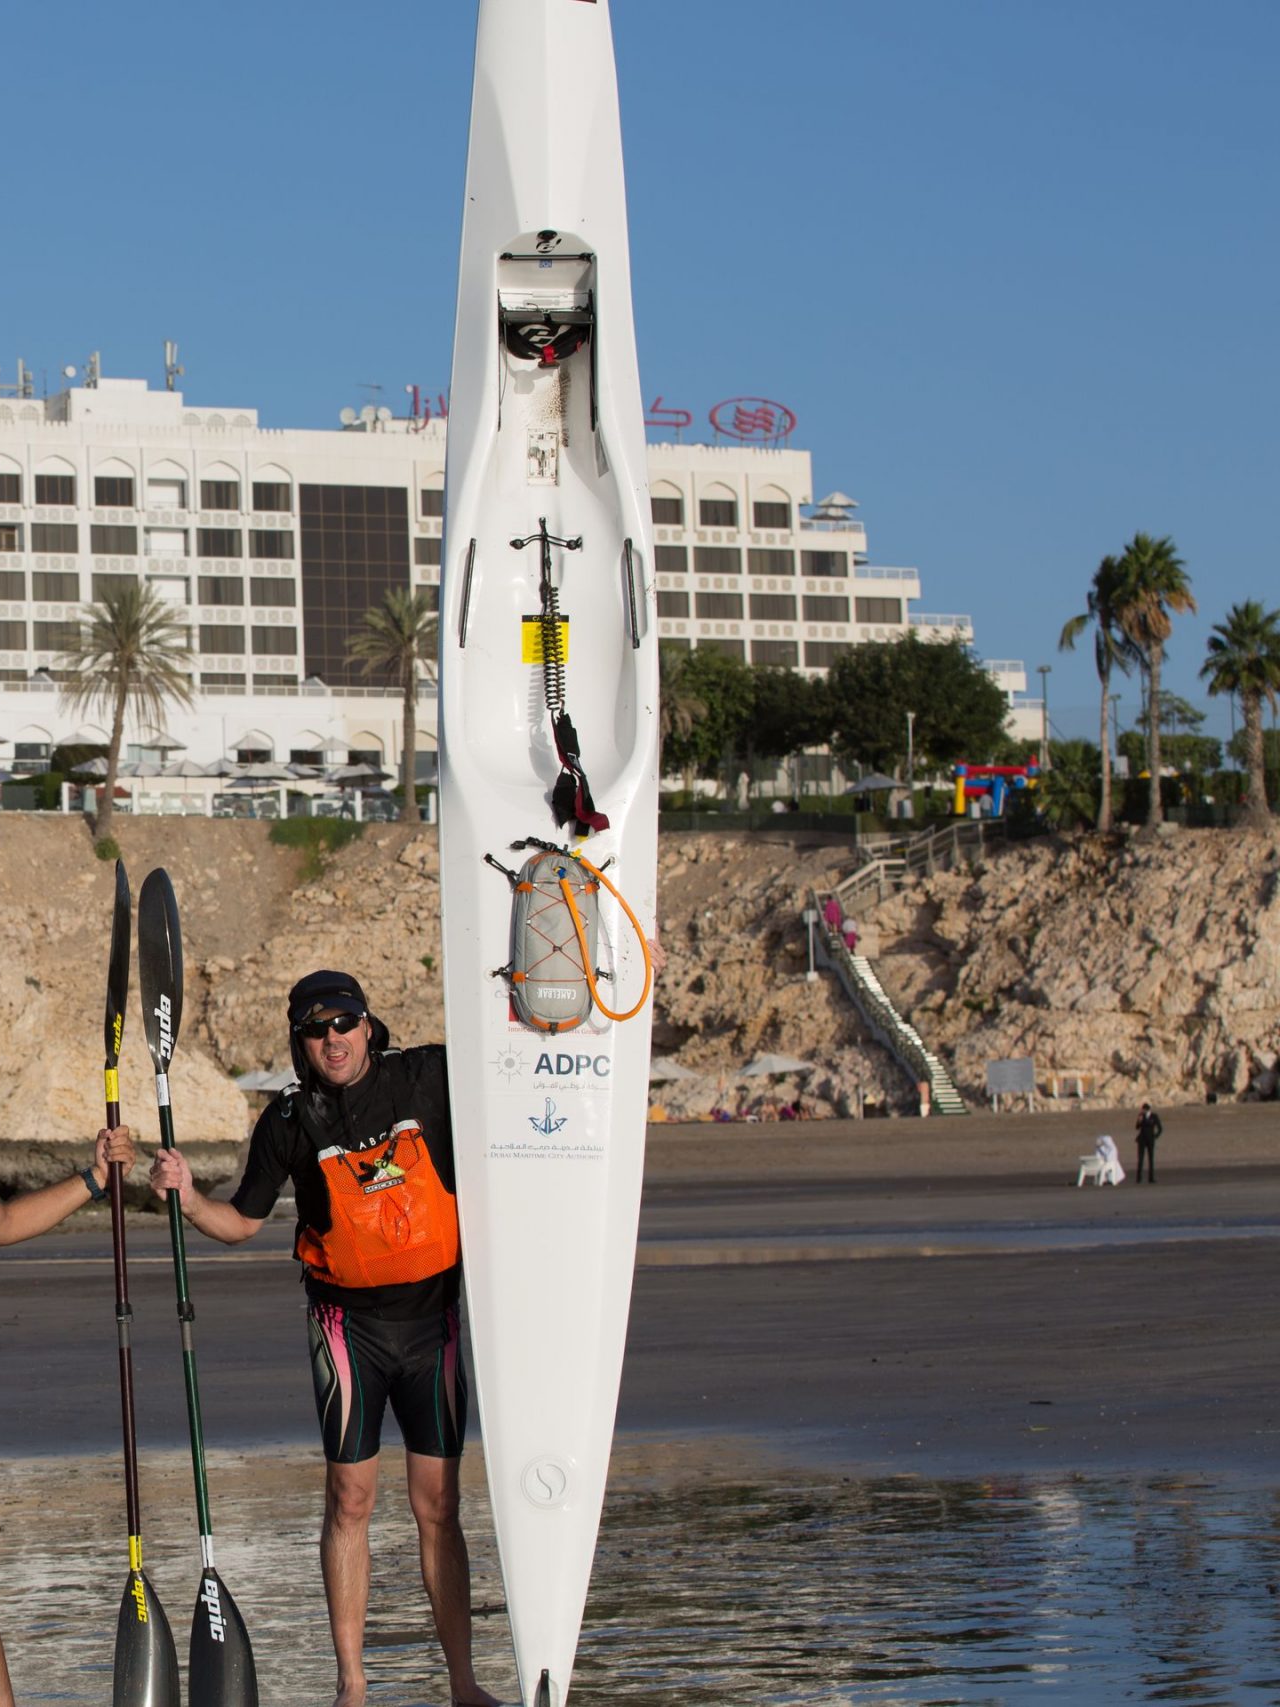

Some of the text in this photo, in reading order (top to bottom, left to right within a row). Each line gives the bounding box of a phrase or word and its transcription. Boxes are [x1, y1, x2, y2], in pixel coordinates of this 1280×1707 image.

[536, 987, 577, 1000] CAMELBAK
[154, 993, 174, 1061] epic
[534, 1053, 611, 1077] ADPC
[131, 1579, 147, 1623] epic
[201, 1578, 227, 1643] epic
